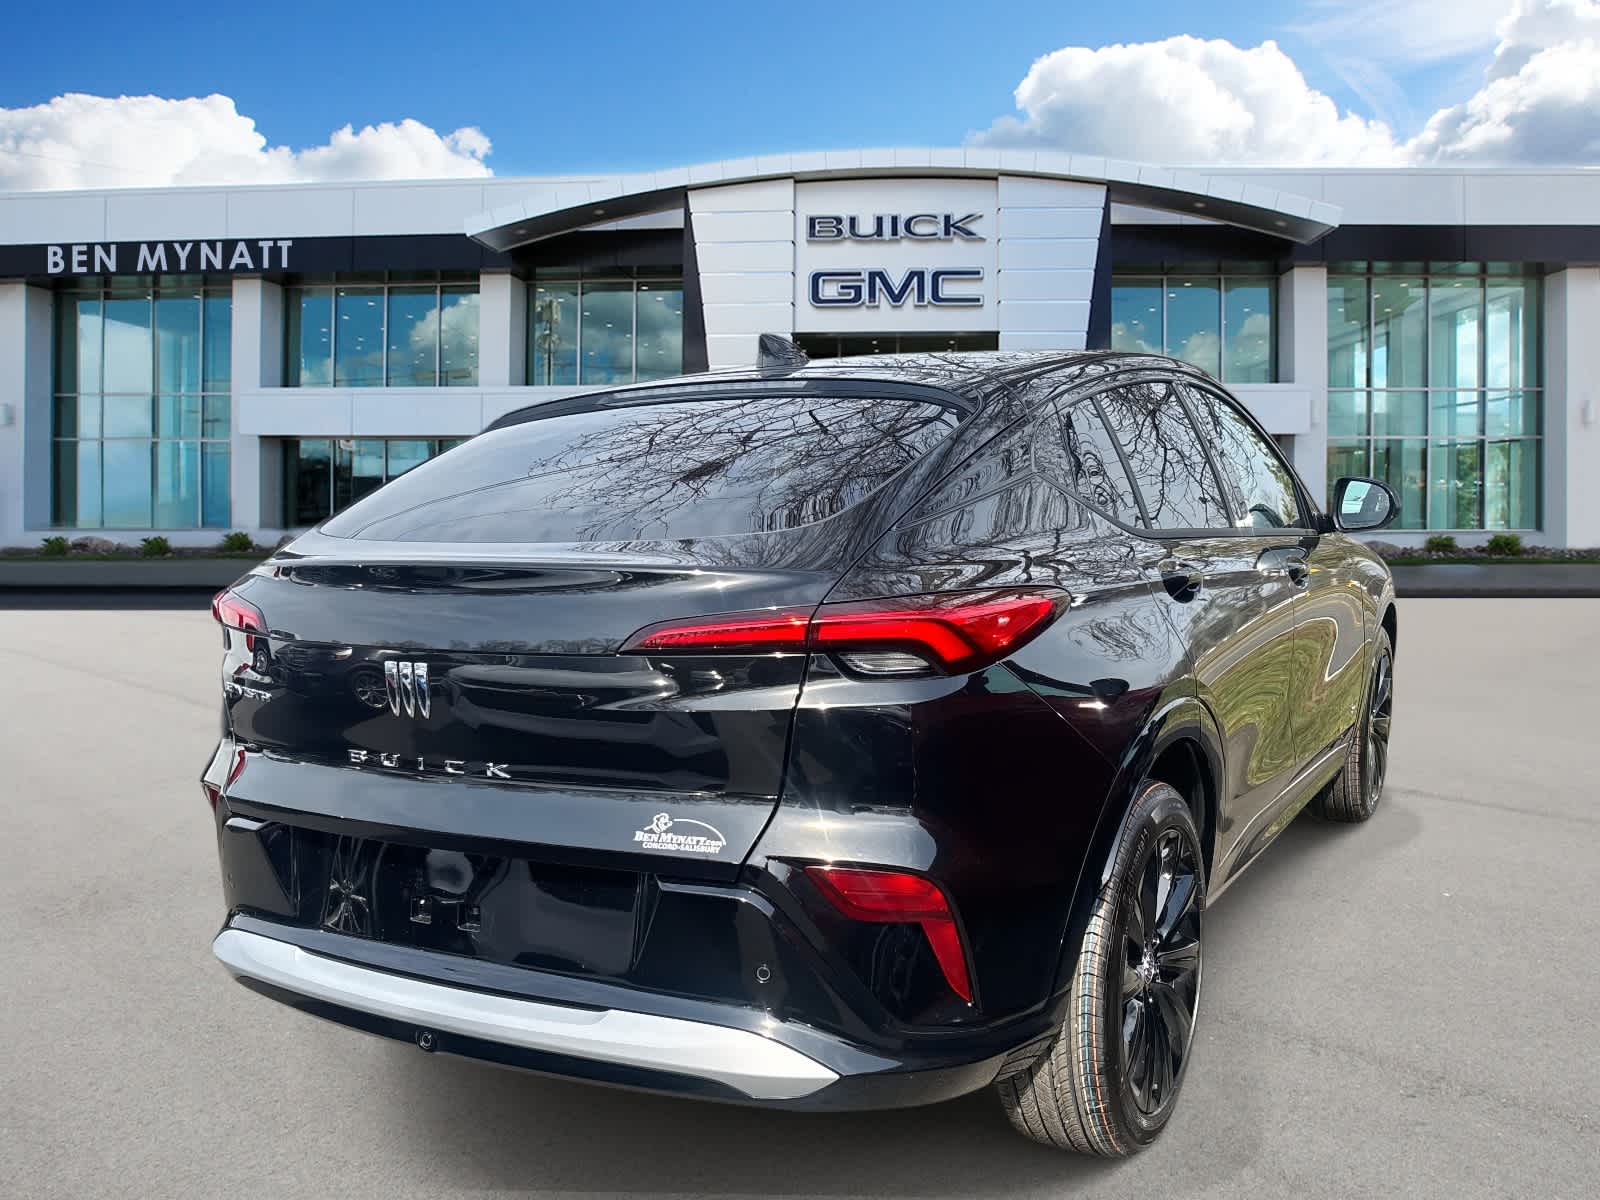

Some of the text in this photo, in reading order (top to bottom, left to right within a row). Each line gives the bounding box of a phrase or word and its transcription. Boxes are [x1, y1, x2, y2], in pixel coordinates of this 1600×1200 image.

[806, 213, 986, 242] BUICK
[47, 240, 293, 274] BEN MYNATT
[809, 267, 984, 308] GMC
[347, 749, 512, 779] BUICK
